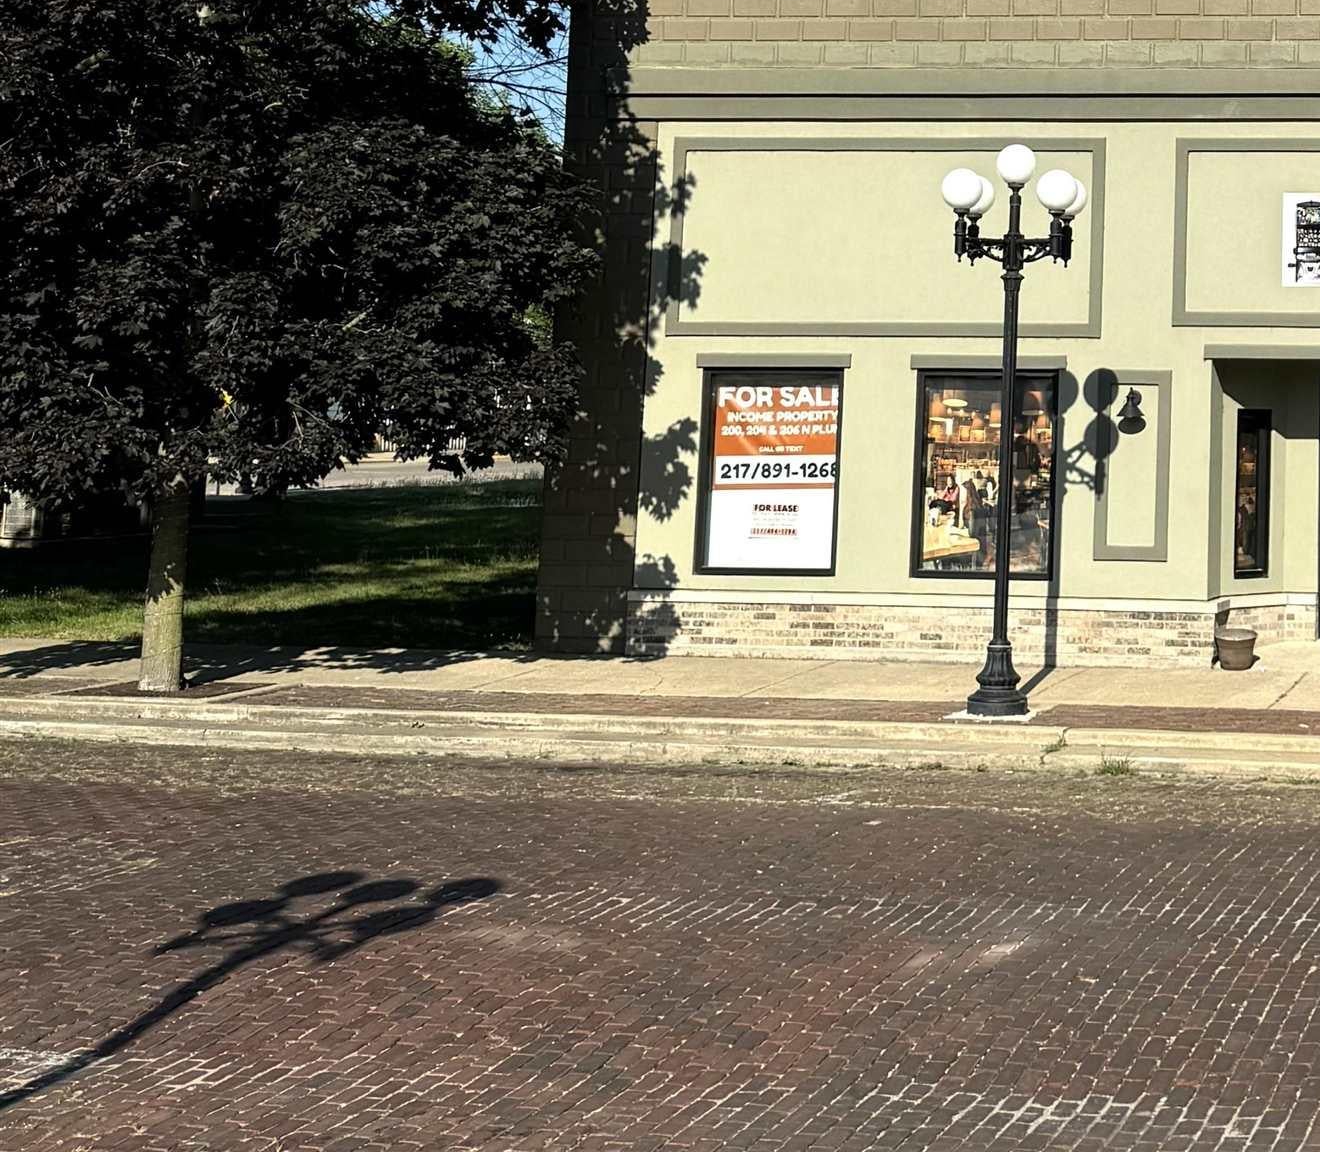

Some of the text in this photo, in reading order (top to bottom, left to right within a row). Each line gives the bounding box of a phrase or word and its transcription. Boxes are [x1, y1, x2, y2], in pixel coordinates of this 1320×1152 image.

[718, 386, 773, 408] FOR
[727, 410, 838, 423] INCOME PROPERTY
[720, 462, 837, 480] 217/891-1268
[754, 504, 799, 513] FOR LEASE
